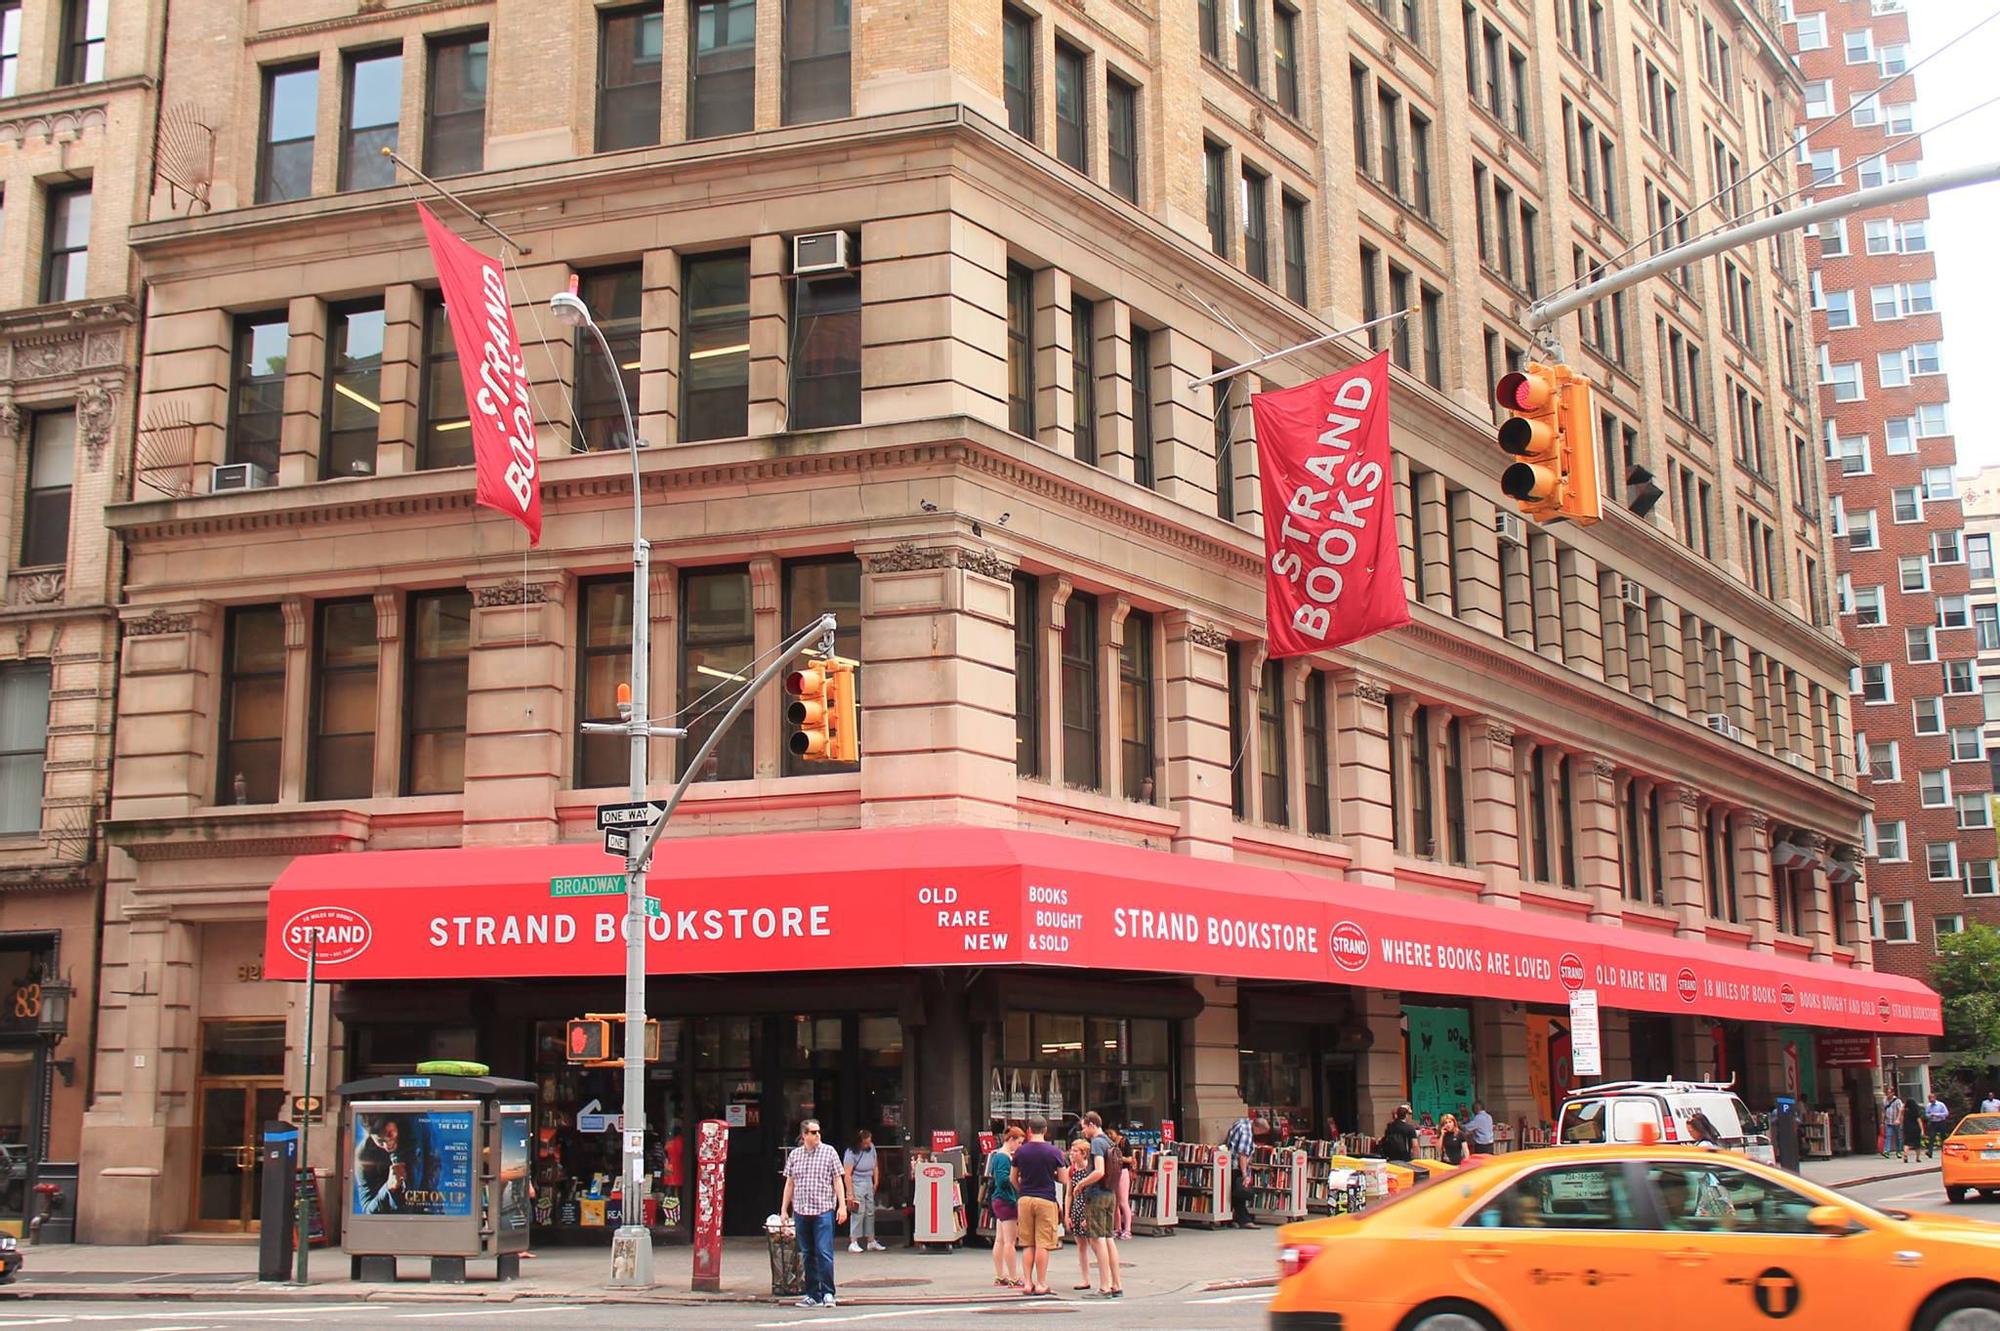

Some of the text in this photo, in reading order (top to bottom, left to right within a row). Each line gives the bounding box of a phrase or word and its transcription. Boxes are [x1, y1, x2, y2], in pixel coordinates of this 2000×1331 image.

[476, 264, 511, 432] STRAND
[1271, 376, 1374, 583] STRAND
[1291, 460, 1383, 641] BOOKS
[604, 809, 648, 823] ONE WAY
[610, 836, 624, 848] ONE
[555, 877, 621, 894] BROADWAY
[918, 887, 957, 904] OLD
[1028, 886, 1068, 905] BOOKS
[938, 911, 990, 927] RARE
[1036, 911, 1083, 929] BOUGHT
[291, 925, 365, 944] STRAND
[429, 914, 577, 947] STRAND
[1114, 907, 1318, 953] STRAND BOOKSTORE
[964, 934, 1008, 950] NEW
[1029, 934, 1069, 952] & SOLD
[1332, 936, 1367, 955] STRAND
[1381, 938, 1551, 980] WHERE BOOKS ARE LOVED
[1560, 965, 1584, 980] STRAND
[1596, 965, 1668, 993] OLD RARE NEW
[15, 984, 41, 1017] 83
[1704, 979, 1777, 1004] 18 MILES OF BOOKS
[1800, 991, 1821, 1009] BOOKS
[1821, 994, 1848, 1012] BOUGHT
[1861, 1000, 1876, 1016] SOLD
[1783, 1104, 1789, 1112] P
[289, 1142, 295, 1156] P
[404, 1190, 466, 1203] GET ON UP
